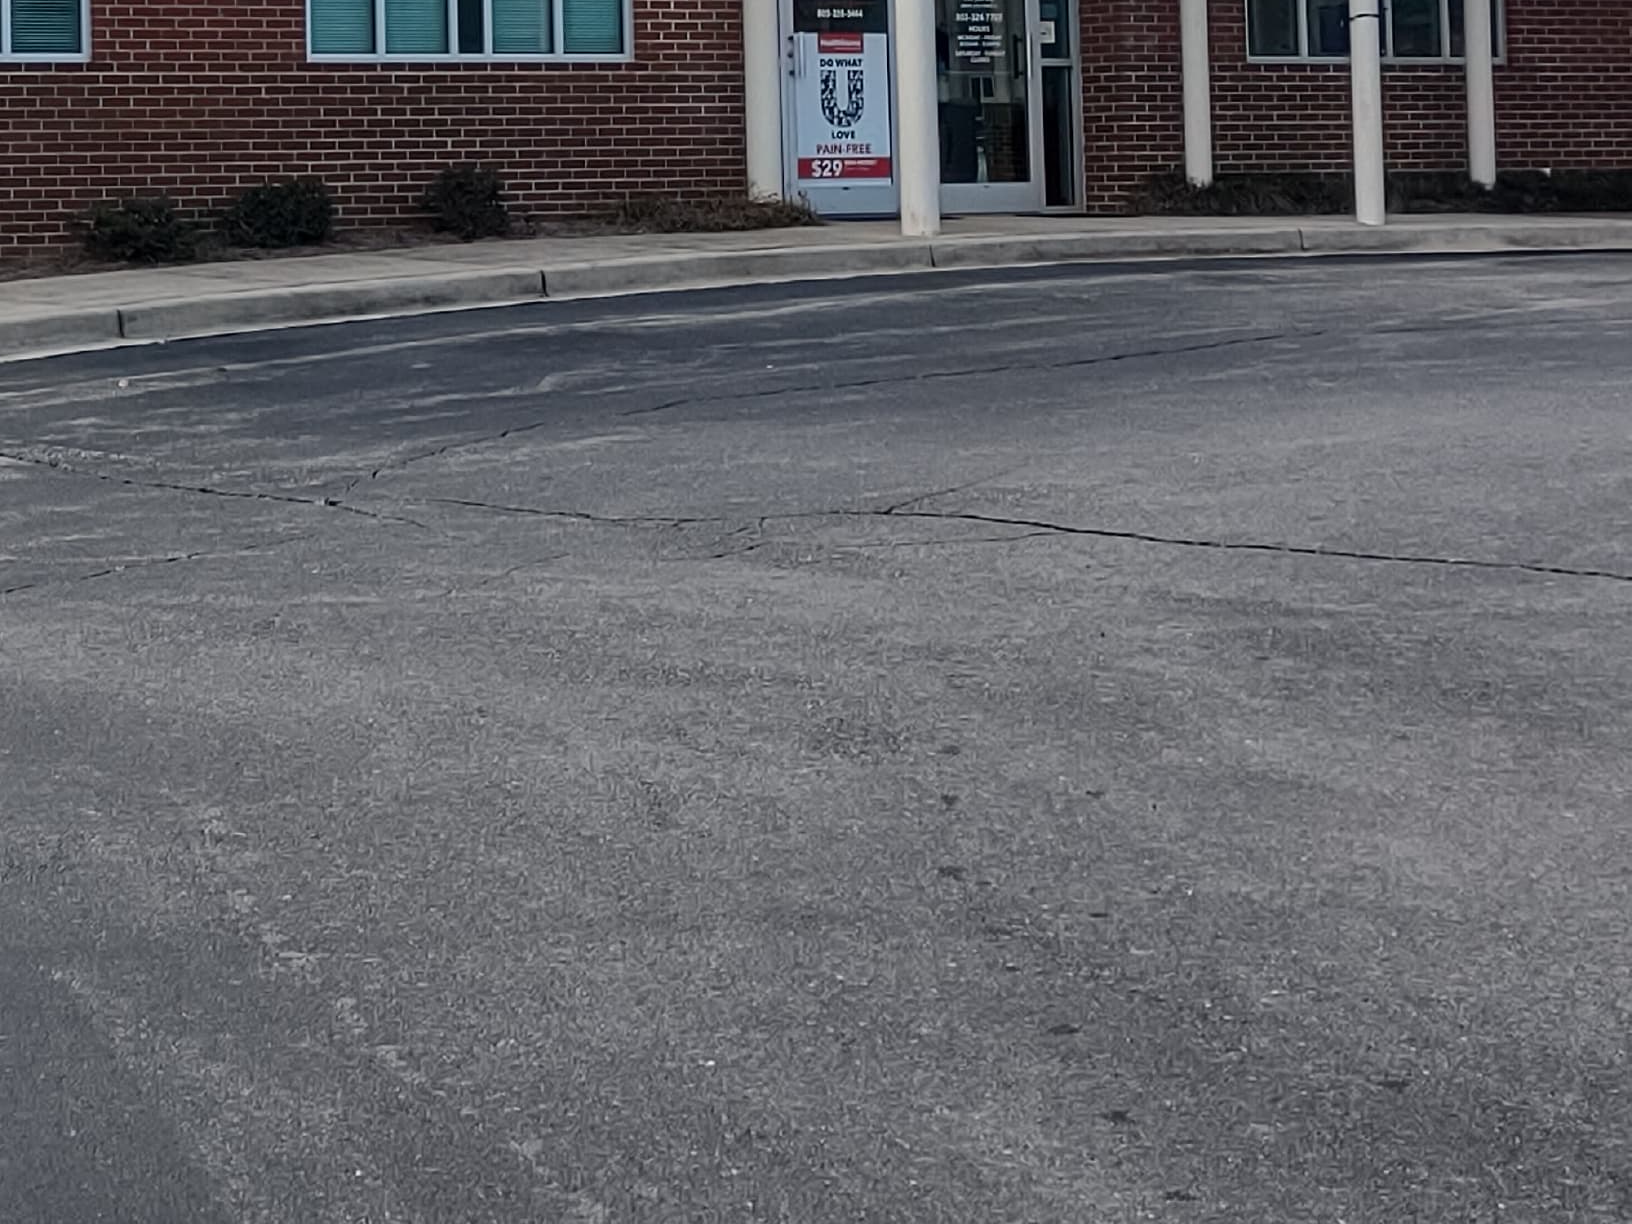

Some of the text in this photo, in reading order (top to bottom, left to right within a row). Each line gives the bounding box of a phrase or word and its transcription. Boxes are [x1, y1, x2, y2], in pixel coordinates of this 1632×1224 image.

[820, 59, 863, 68] DO WHAT
[831, 130, 856, 140] LOVE
[811, 159, 843, 178] $29
